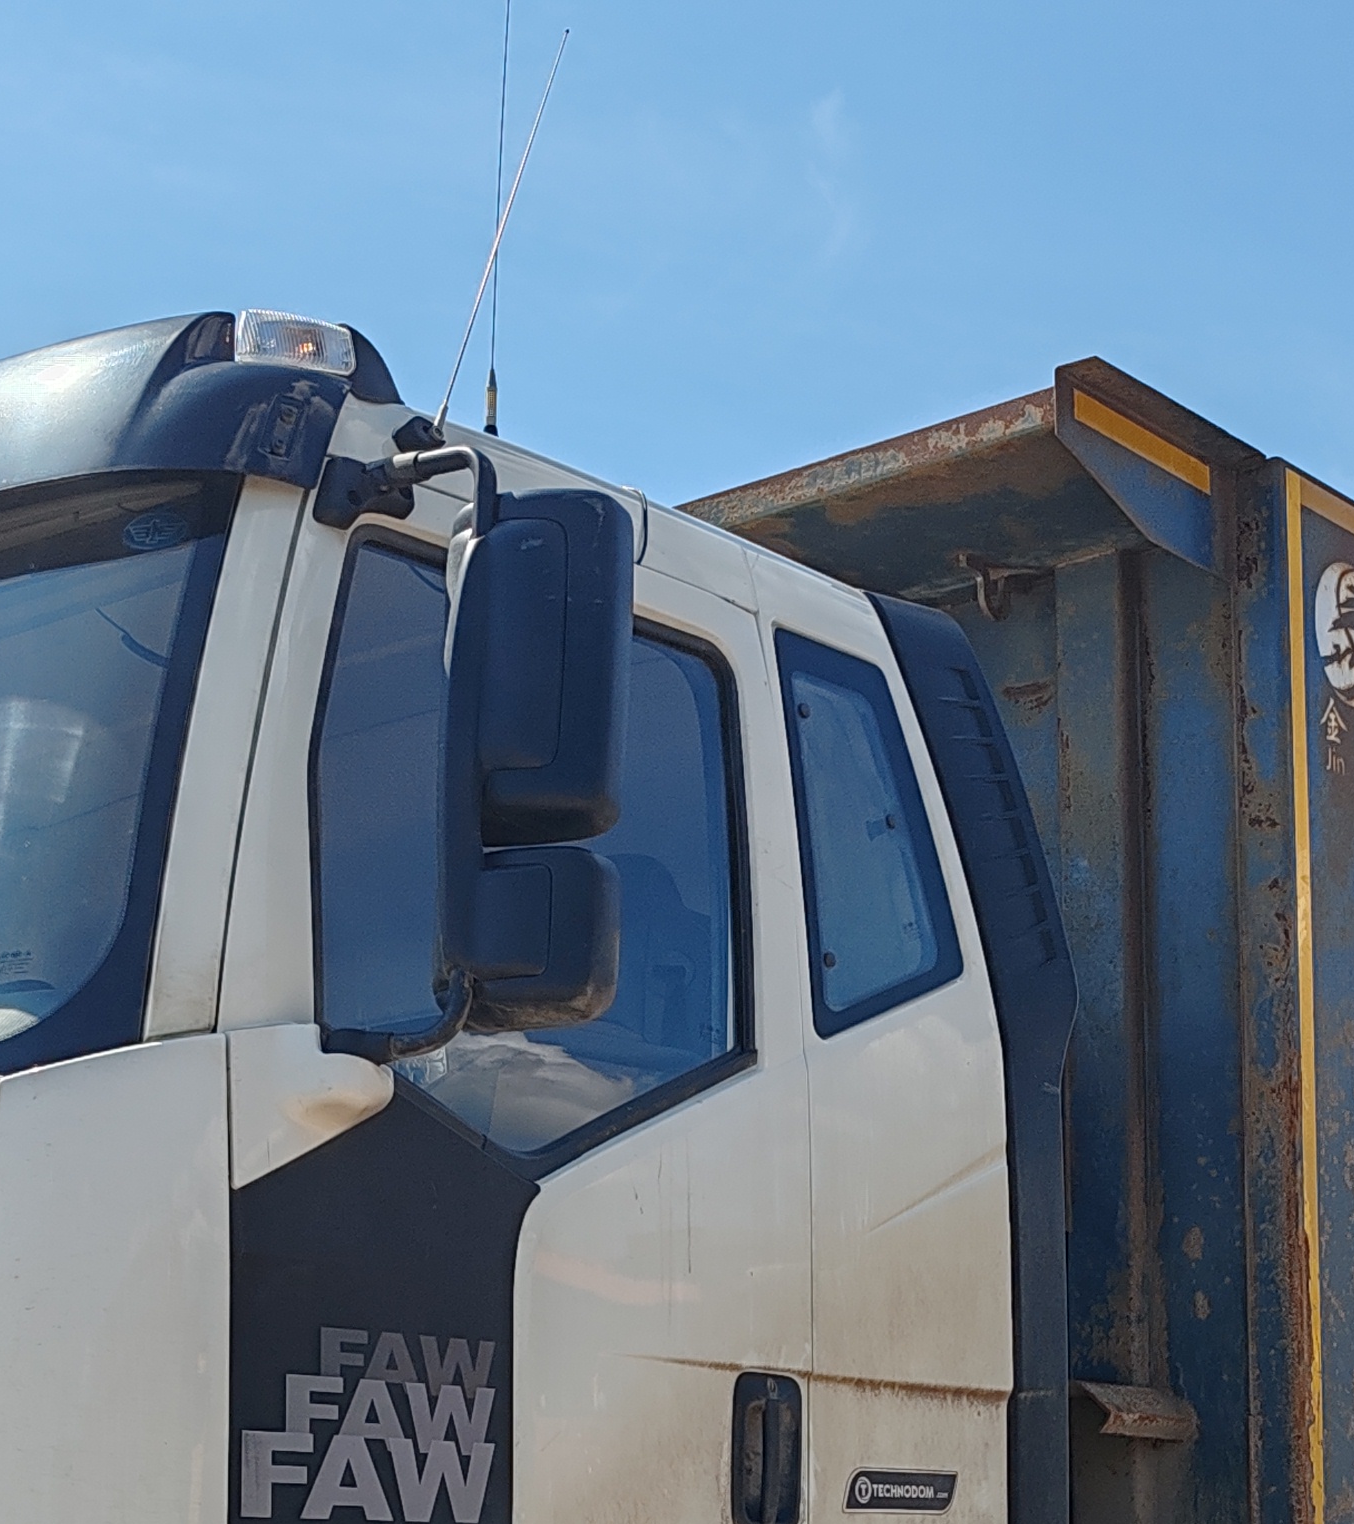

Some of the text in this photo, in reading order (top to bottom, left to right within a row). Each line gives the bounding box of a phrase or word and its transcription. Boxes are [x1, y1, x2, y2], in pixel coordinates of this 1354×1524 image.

[1326, 747, 1345, 776] Jin
[319, 1326, 495, 1399] FAW
[285, 1373, 496, 1456] FAW
[240, 1429, 496, 1524] FAW
[872, 1483, 934, 1498] TECHNODOM
